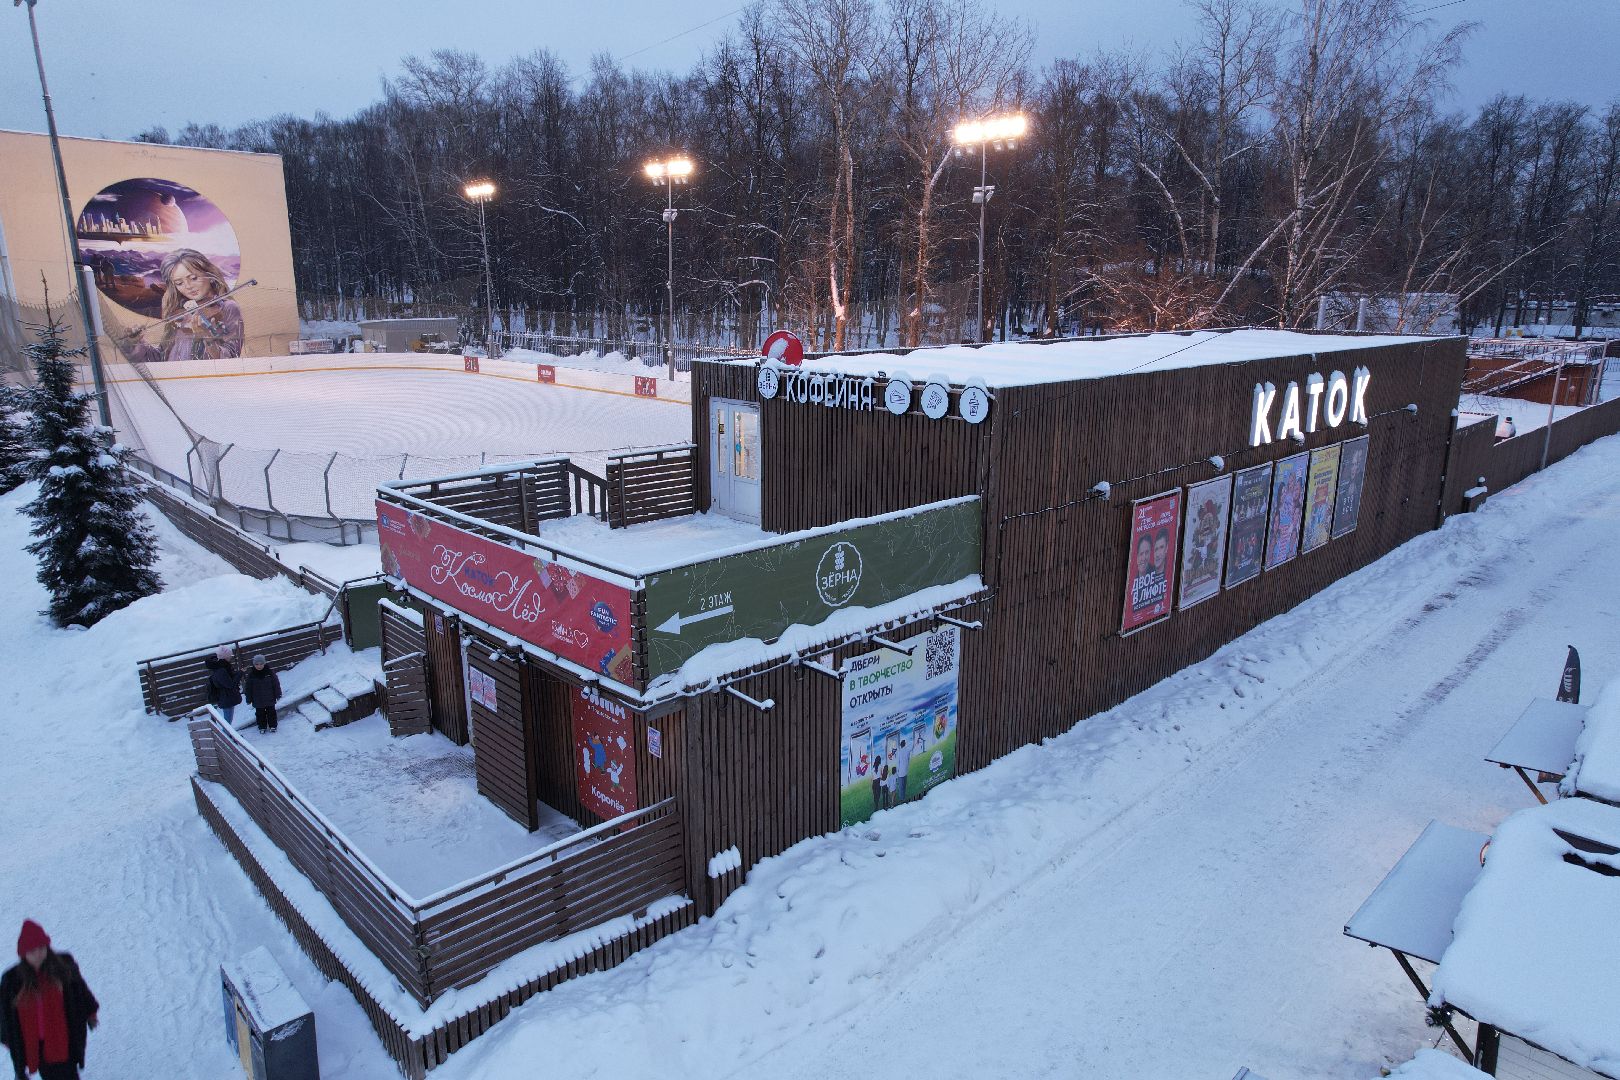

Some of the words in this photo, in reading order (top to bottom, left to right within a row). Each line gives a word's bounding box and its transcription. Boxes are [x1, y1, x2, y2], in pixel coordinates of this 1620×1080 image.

[786, 372, 872, 411] КОФЕЙНЯ
[1249, 370, 1370, 446] КАТОК
[821, 568, 858, 589] ЗЁРНА
[1131, 571, 1156, 595] ДВОЕ
[700, 597, 706, 611] 2
[708, 591, 733, 608] ЭТАЖ
[1132, 592, 1138, 606] В
[1138, 580, 1168, 603] ЛИФТЕ
[597, 607, 610, 615] FUN
[849, 655, 880, 673] ДВЕРИ
[849, 680, 855, 691] В
[858, 659, 913, 688] ТВОРЧЕСТВО
[849, 684, 893, 709] ОТКРЫТЫ
[590, 784, 625, 814] Королёв
